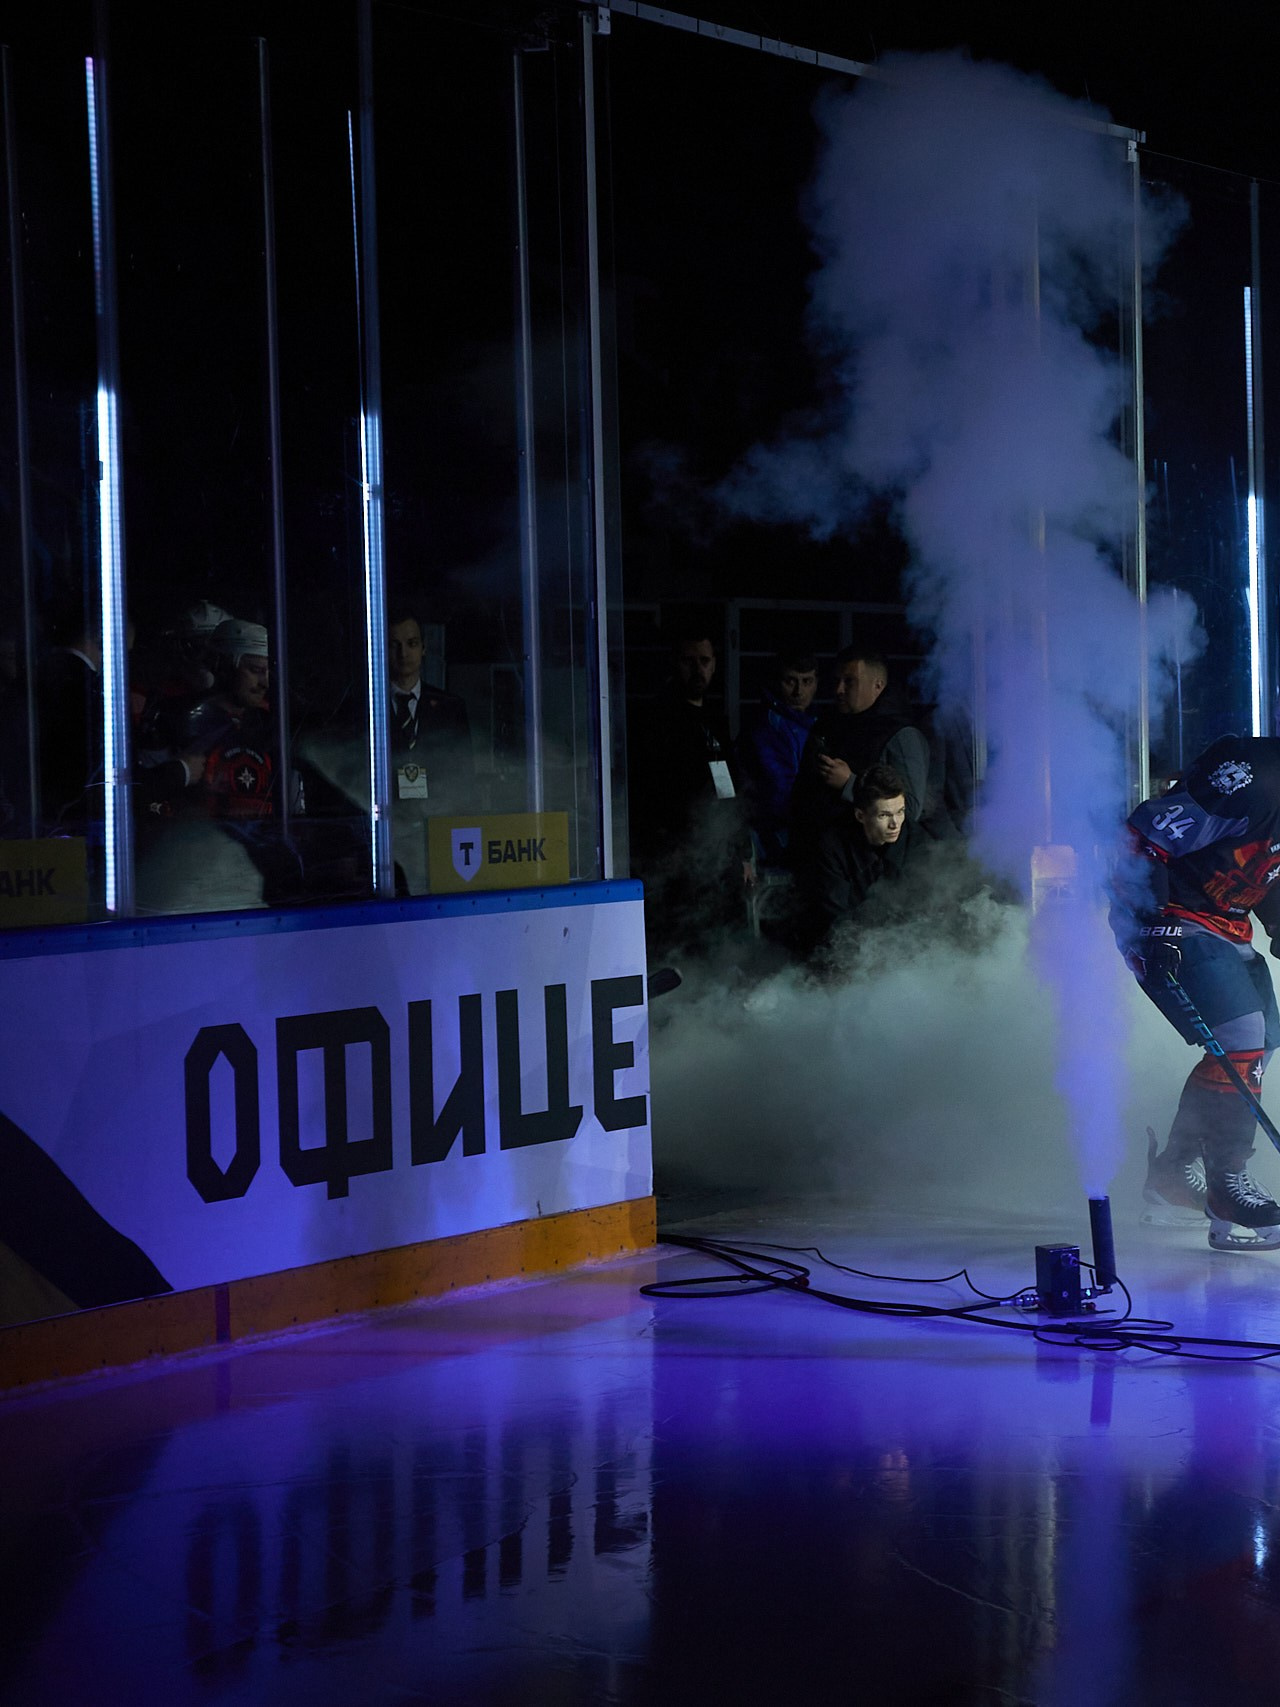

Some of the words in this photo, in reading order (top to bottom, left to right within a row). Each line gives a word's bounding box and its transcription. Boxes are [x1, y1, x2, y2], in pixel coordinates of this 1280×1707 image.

[1152, 804, 1196, 841] 34
[488, 838, 546, 864] БАНК
[184, 974, 648, 1204] ОФИЦЕ
